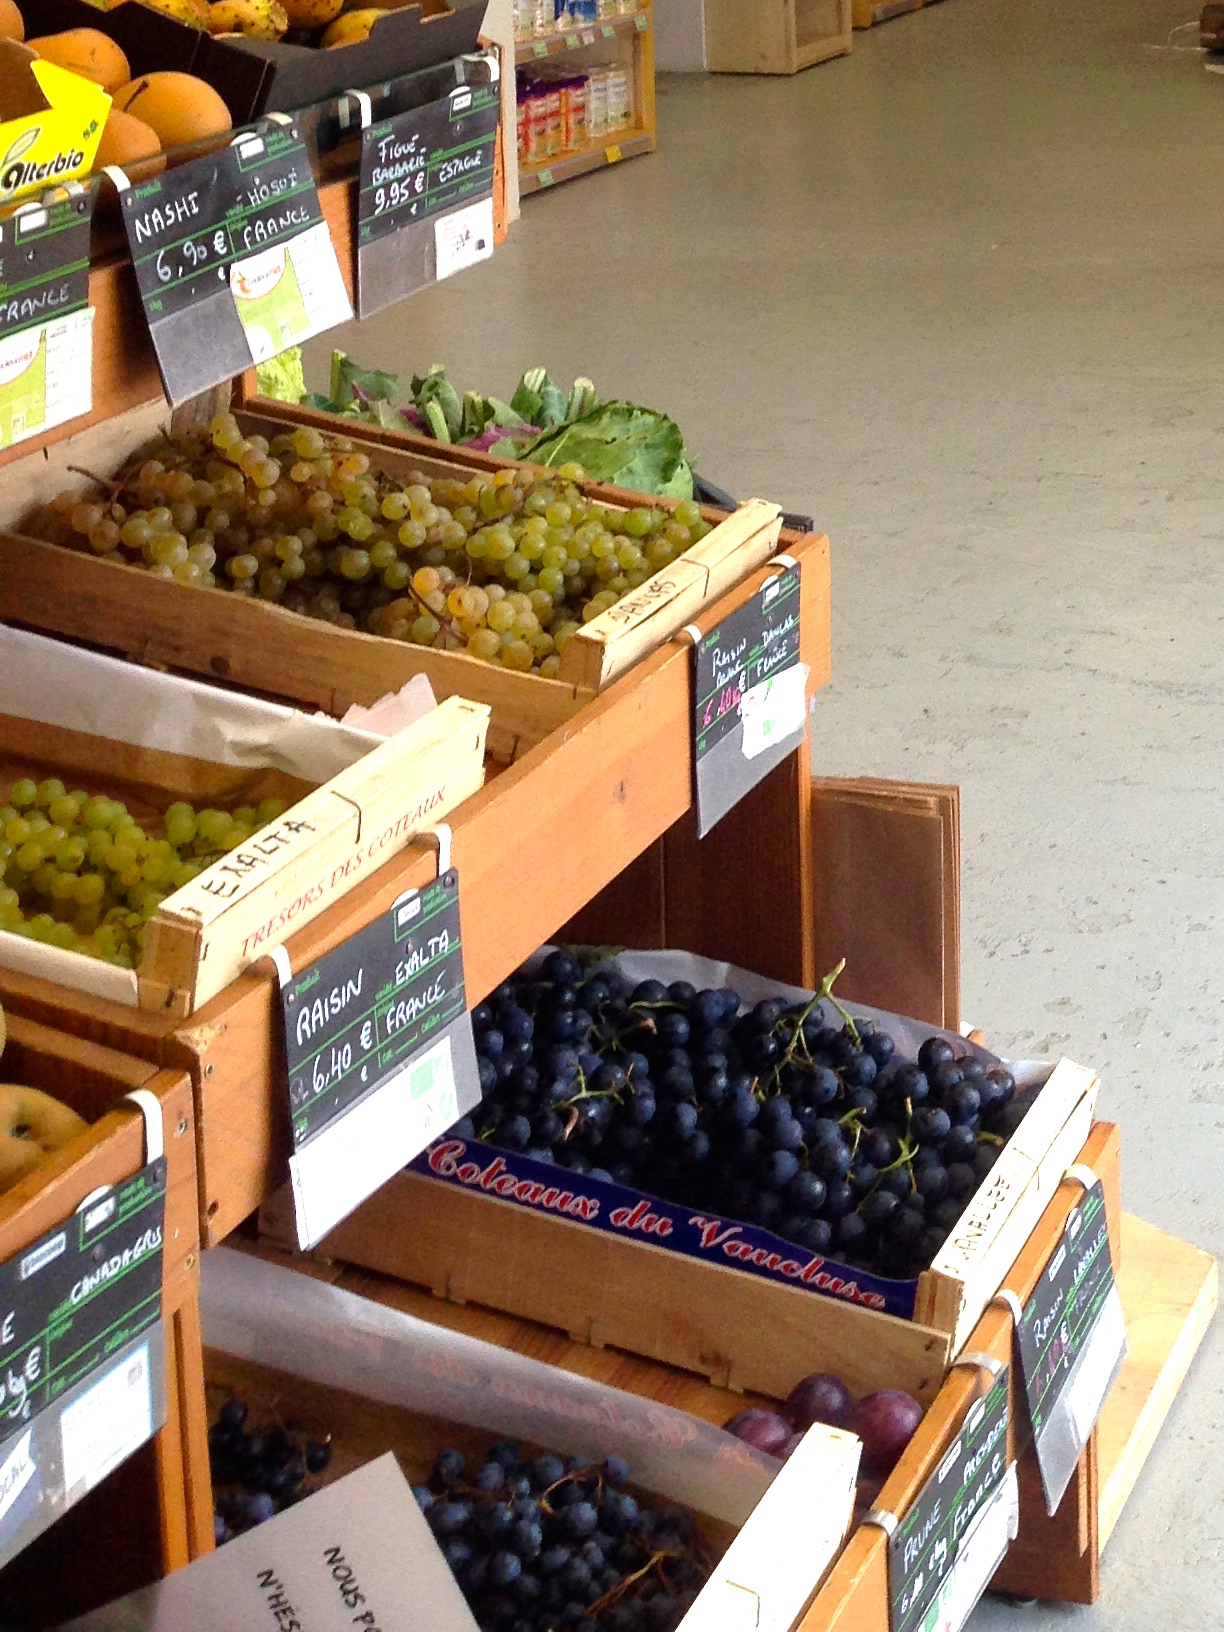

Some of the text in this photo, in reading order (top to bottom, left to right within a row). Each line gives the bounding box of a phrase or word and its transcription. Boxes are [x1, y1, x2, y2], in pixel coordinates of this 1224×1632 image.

[135, 192, 200, 244] NASHI
[243, 206, 310, 251] FRANCE
[374, 176, 410, 216] 9,95
[156, 242, 207, 283] 6,90
[201, 819, 315, 899] EXALTA
[241, 785, 447, 957] TRESORS DES COTEAUX
[296, 968, 363, 1046] RAISIN
[395, 929, 449, 985] EXALTA
[312, 1043, 352, 1094] 6,40
[386, 969, 447, 1034] FRANCE
[426, 1139, 887, 1310] Coteaux du Vaucluse
[904, 1498, 942, 1573] PRUNE
[323, 1545, 366, 1609] NOUS
